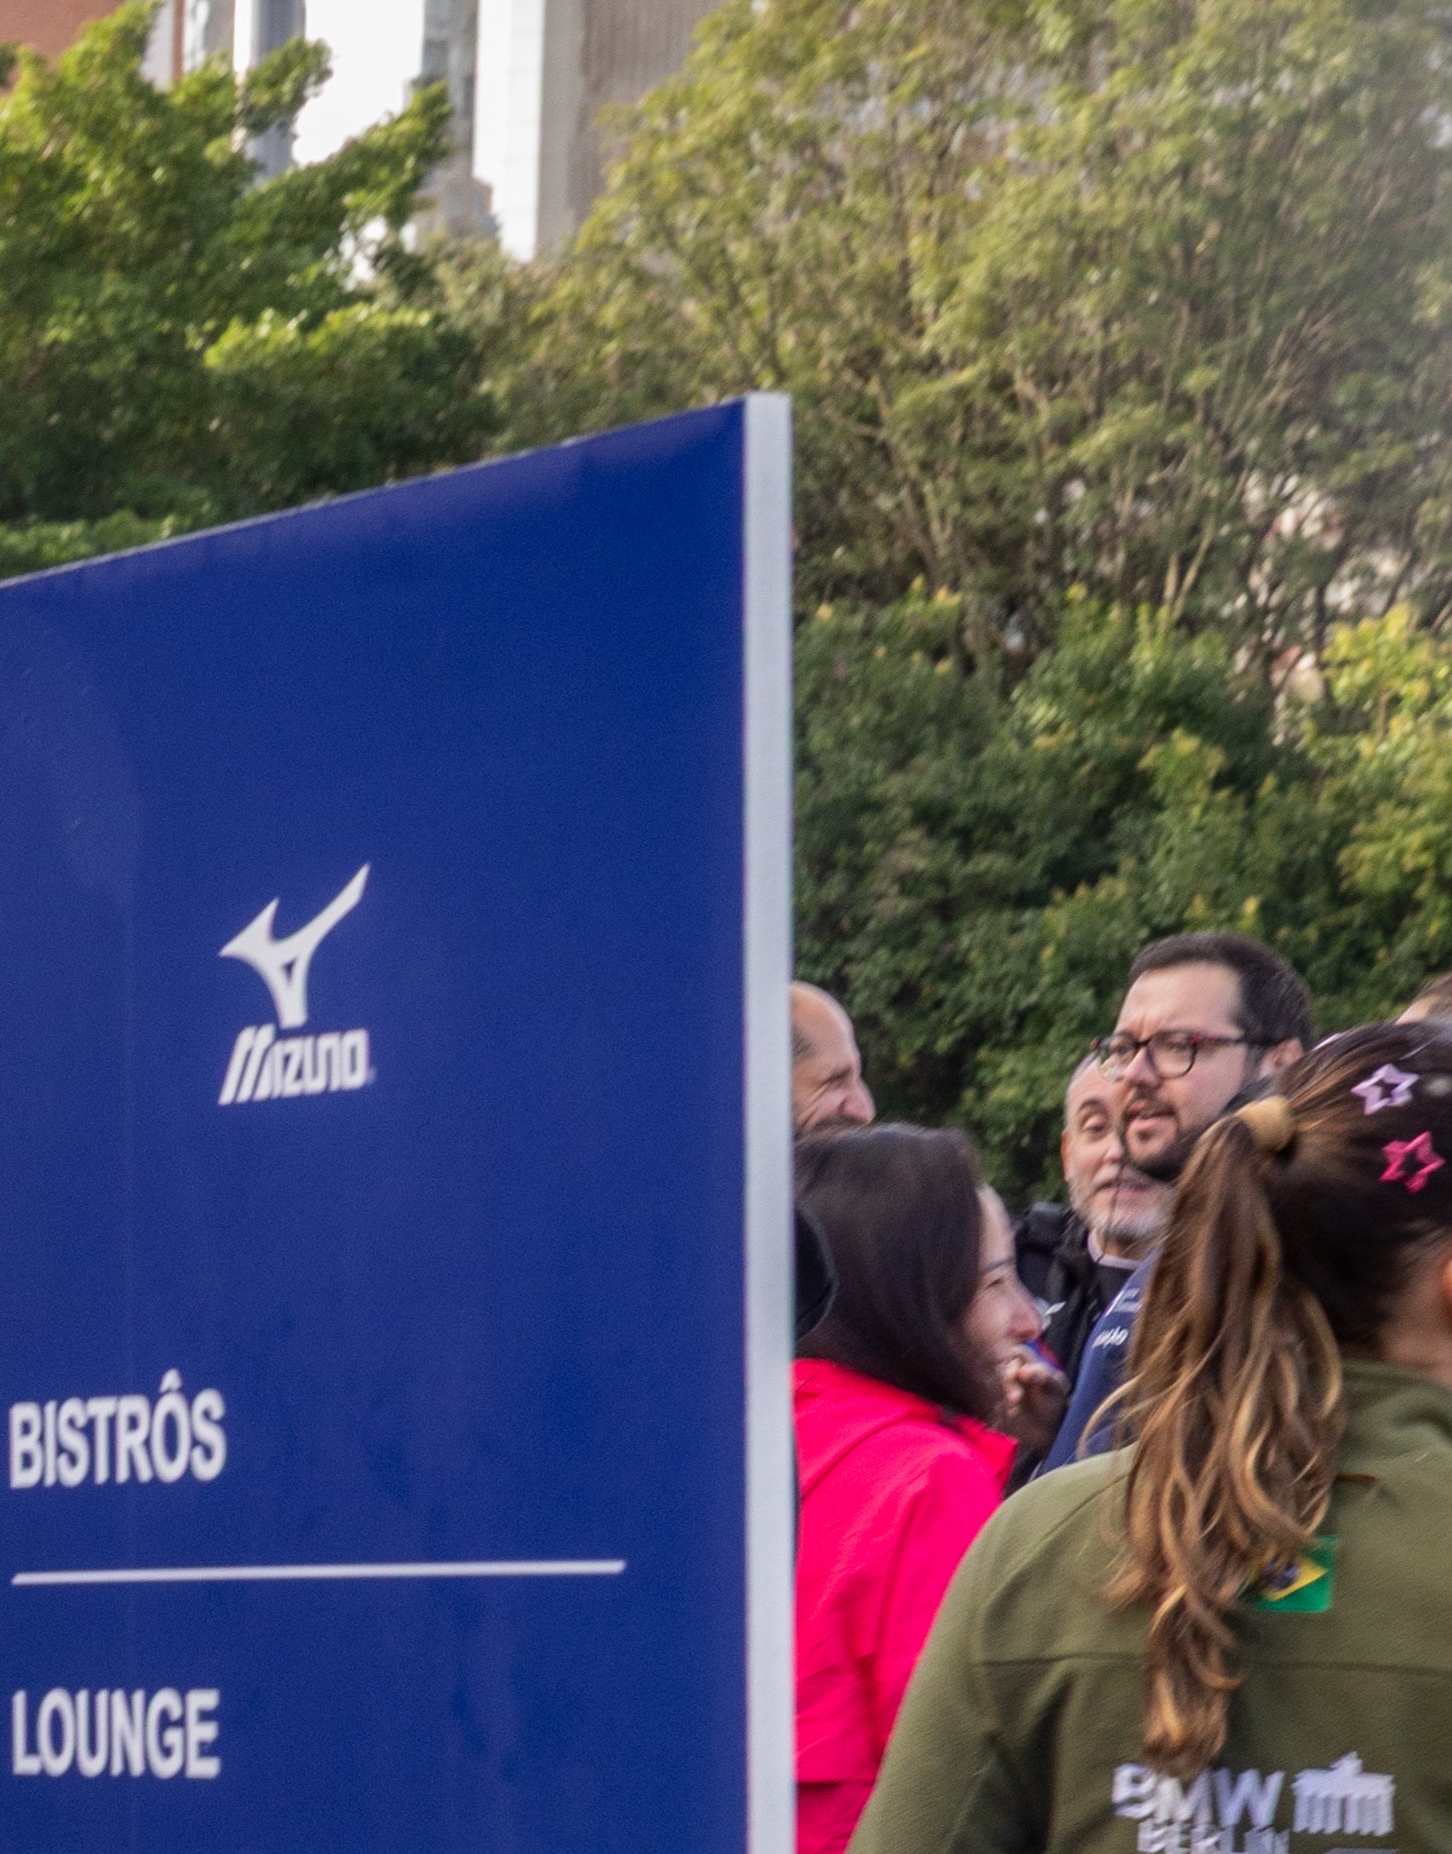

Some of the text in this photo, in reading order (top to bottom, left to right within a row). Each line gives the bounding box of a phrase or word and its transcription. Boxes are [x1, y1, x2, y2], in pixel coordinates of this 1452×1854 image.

[8, 1368, 227, 1488] BISTRÔS
[11, 1687, 222, 1780] LOUNGE
[1111, 1761, 1286, 1828] BMW
